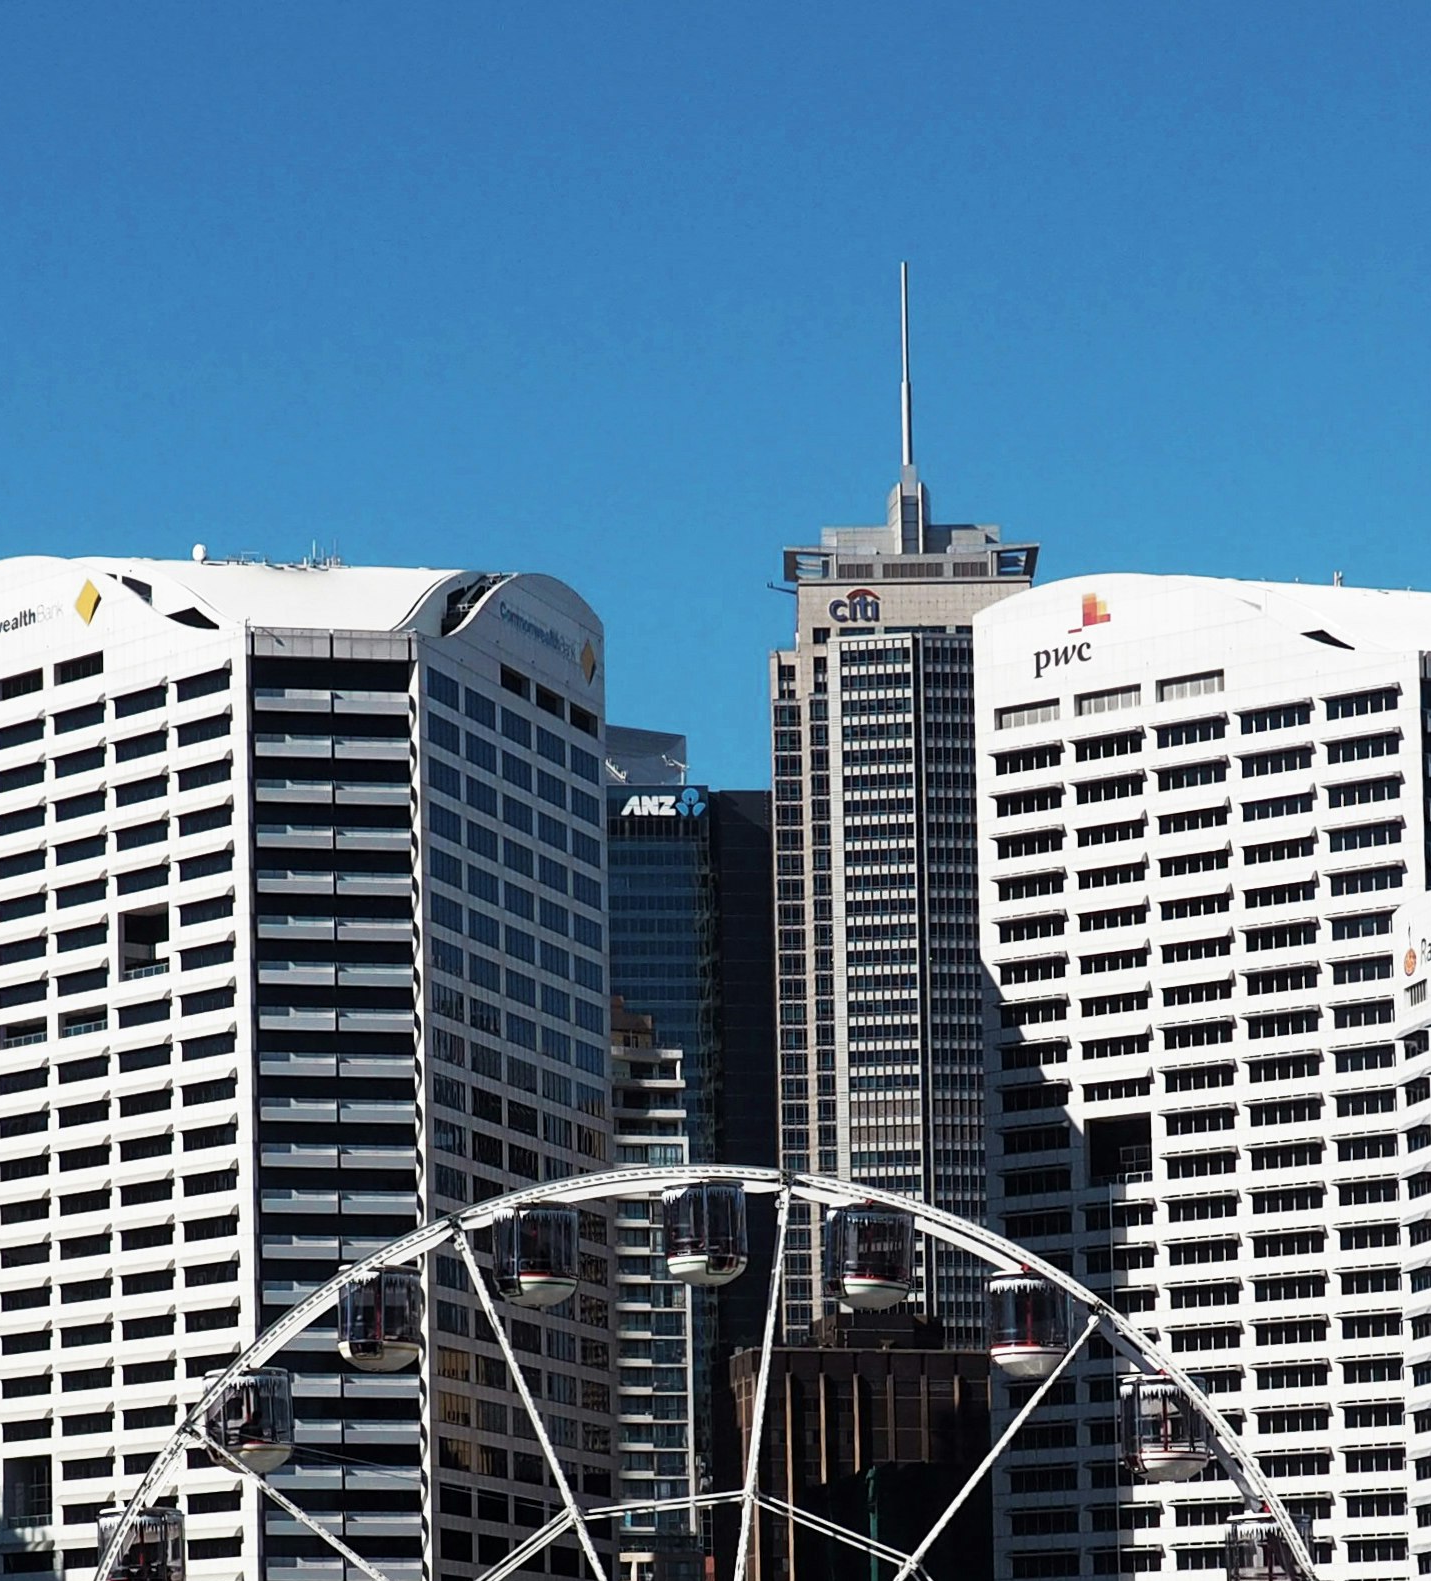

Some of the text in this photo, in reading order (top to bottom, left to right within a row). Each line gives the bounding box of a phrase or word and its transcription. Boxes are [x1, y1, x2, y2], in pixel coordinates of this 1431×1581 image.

[829, 594, 880, 623] citi
[1033, 638, 1093, 679] pwc
[621, 795, 676, 816] ANZ
